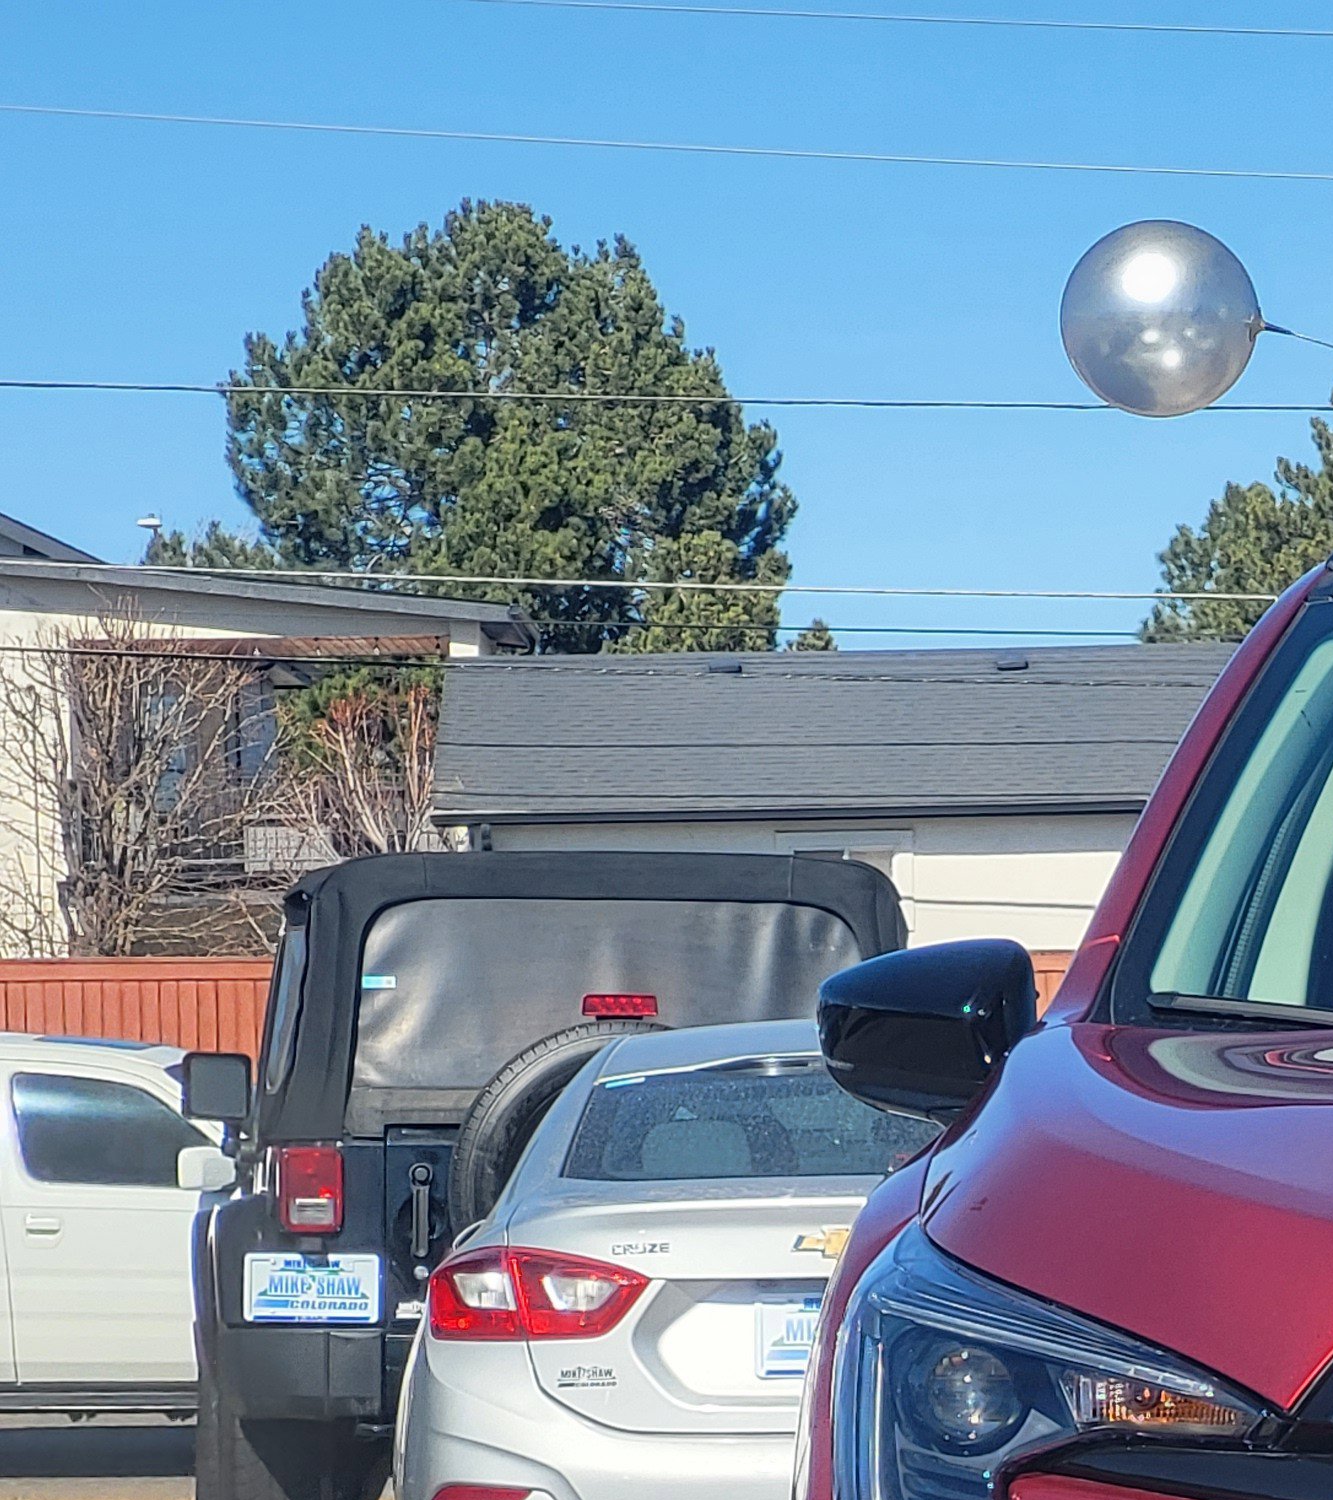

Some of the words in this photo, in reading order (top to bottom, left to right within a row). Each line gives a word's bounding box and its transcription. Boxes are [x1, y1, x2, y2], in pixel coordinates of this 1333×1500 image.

[612, 1243, 670, 1256] CRUZE
[268, 1275, 308, 1294] MIKE
[316, 1275, 361, 1296] SHAW
[290, 1300, 369, 1311] COLORADO
